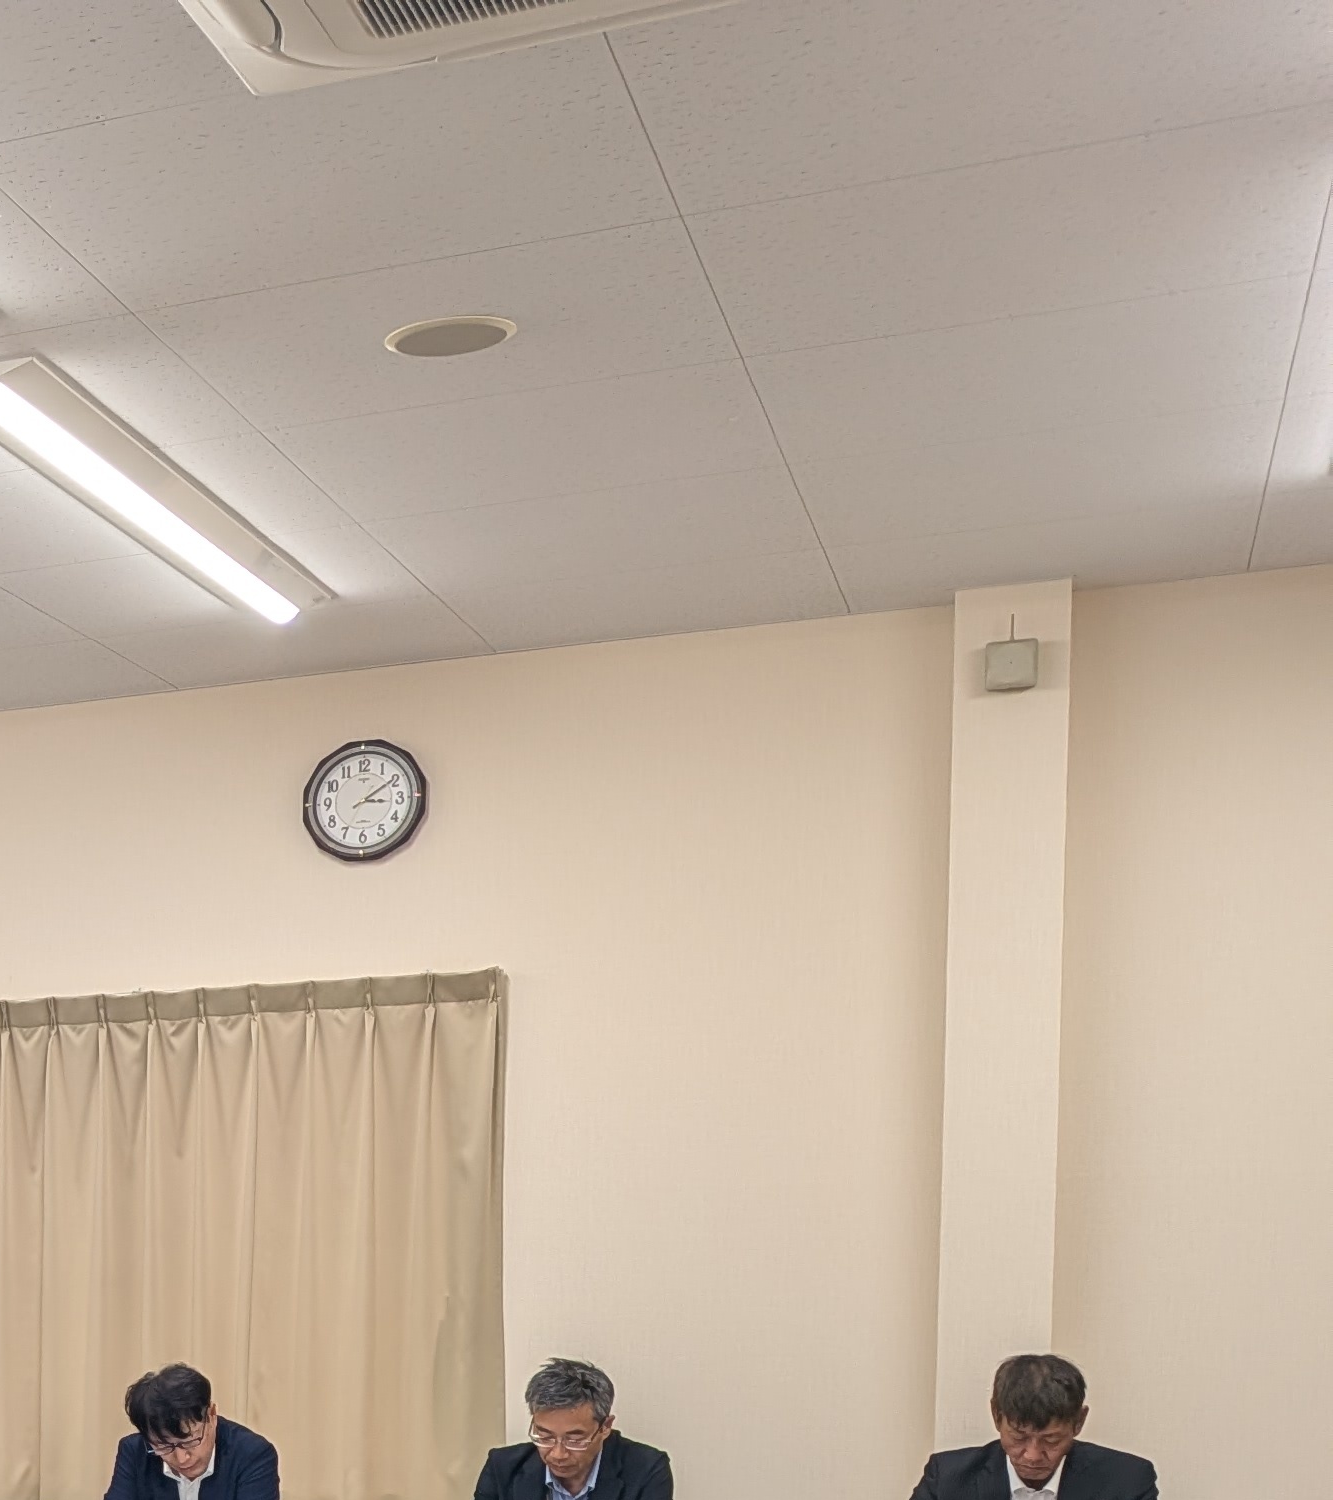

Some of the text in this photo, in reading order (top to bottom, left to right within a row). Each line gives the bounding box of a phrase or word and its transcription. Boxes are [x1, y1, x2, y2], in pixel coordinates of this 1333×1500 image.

[341, 765, 351, 779] 11
[358, 759, 371, 773] 12
[380, 762, 385, 775] 1
[327, 779, 339, 793] 10
[391, 774, 400, 787] 2
[323, 797, 332, 811] 9
[395, 791, 405, 805] 3
[327, 815, 337, 829] 8
[390, 810, 399, 823] 4
[341, 826, 350, 840] 7
[358, 830, 367, 844] 6
[376, 824, 386, 837] 5
